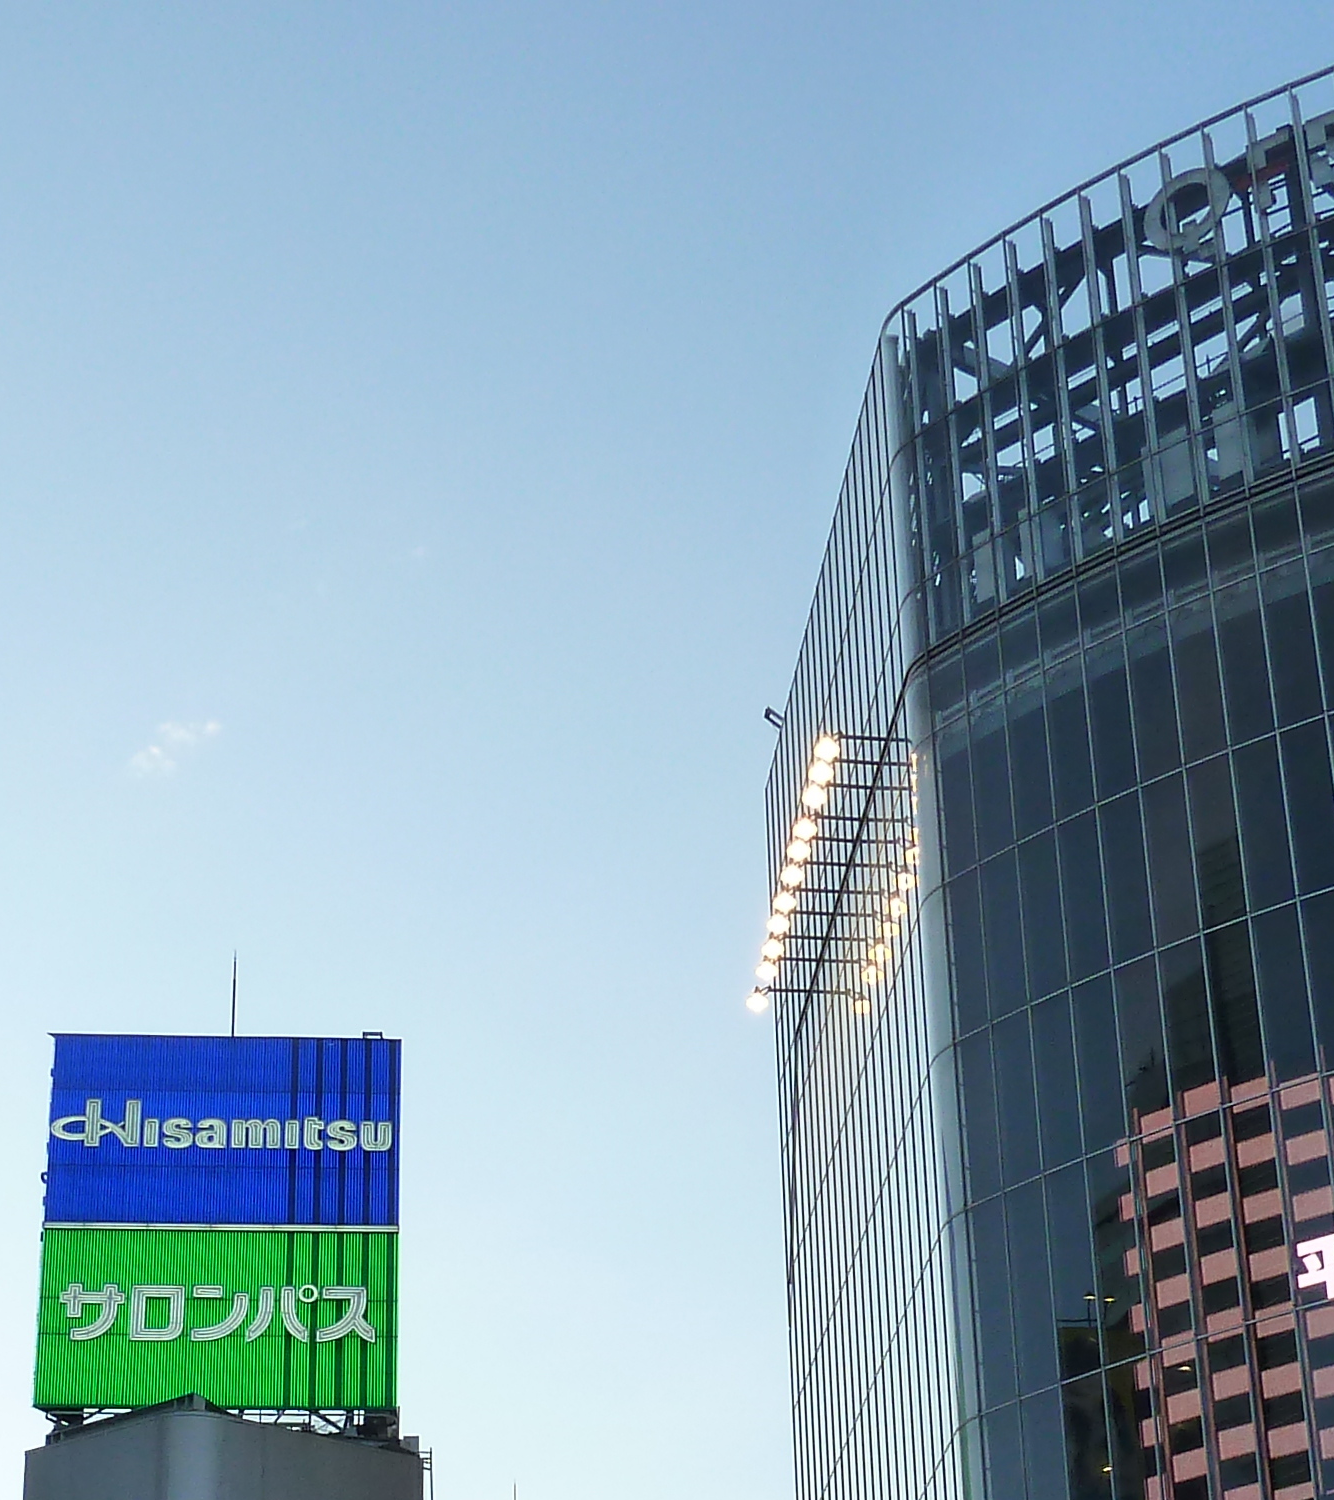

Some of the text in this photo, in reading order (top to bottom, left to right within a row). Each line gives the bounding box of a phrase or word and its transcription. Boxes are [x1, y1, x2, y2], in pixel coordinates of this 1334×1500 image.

[51, 1098, 393, 1152] Hisamitsu
[59, 1283, 377, 1345] サロンパス
